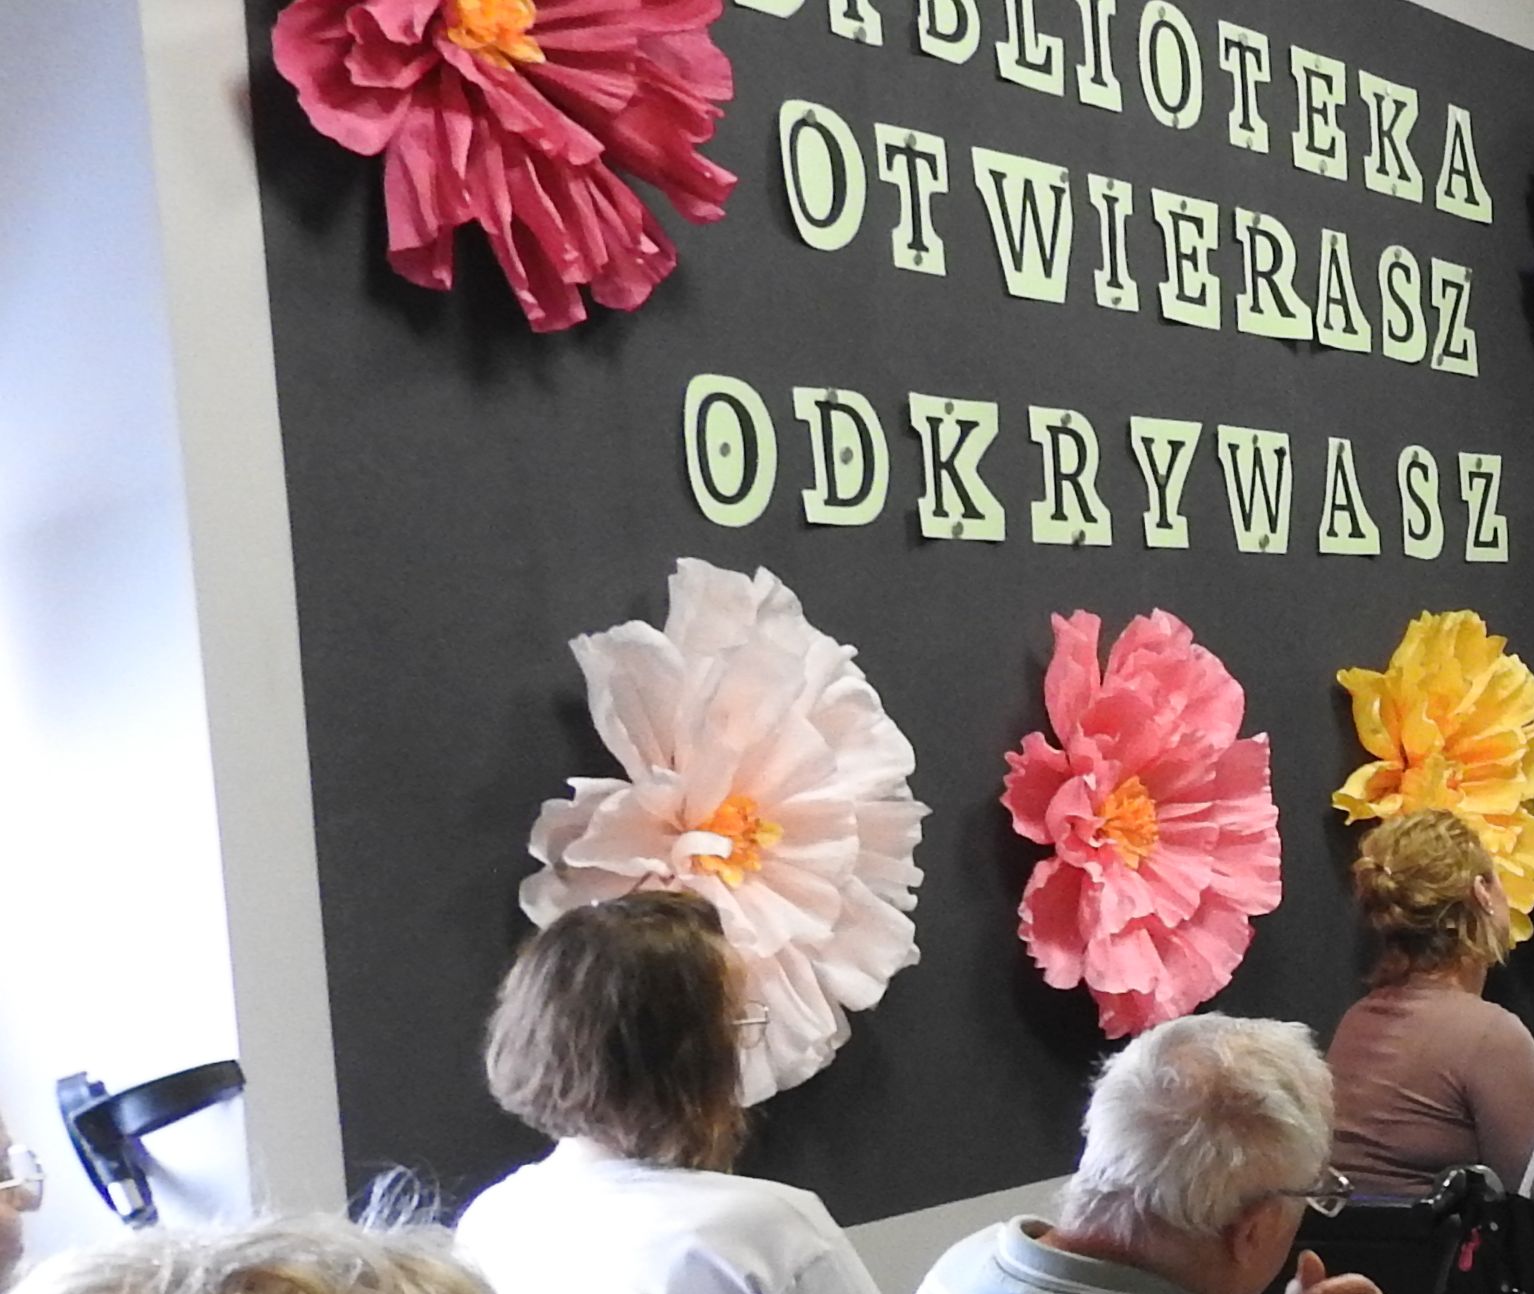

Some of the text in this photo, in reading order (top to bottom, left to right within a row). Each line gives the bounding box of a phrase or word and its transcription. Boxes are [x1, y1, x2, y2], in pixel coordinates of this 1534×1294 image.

[736, 0, 1492, 222] LIOTEKA
[781, 101, 1477, 375] OTWIERASZ
[686, 375, 1508, 562] ODKRYWASZ
